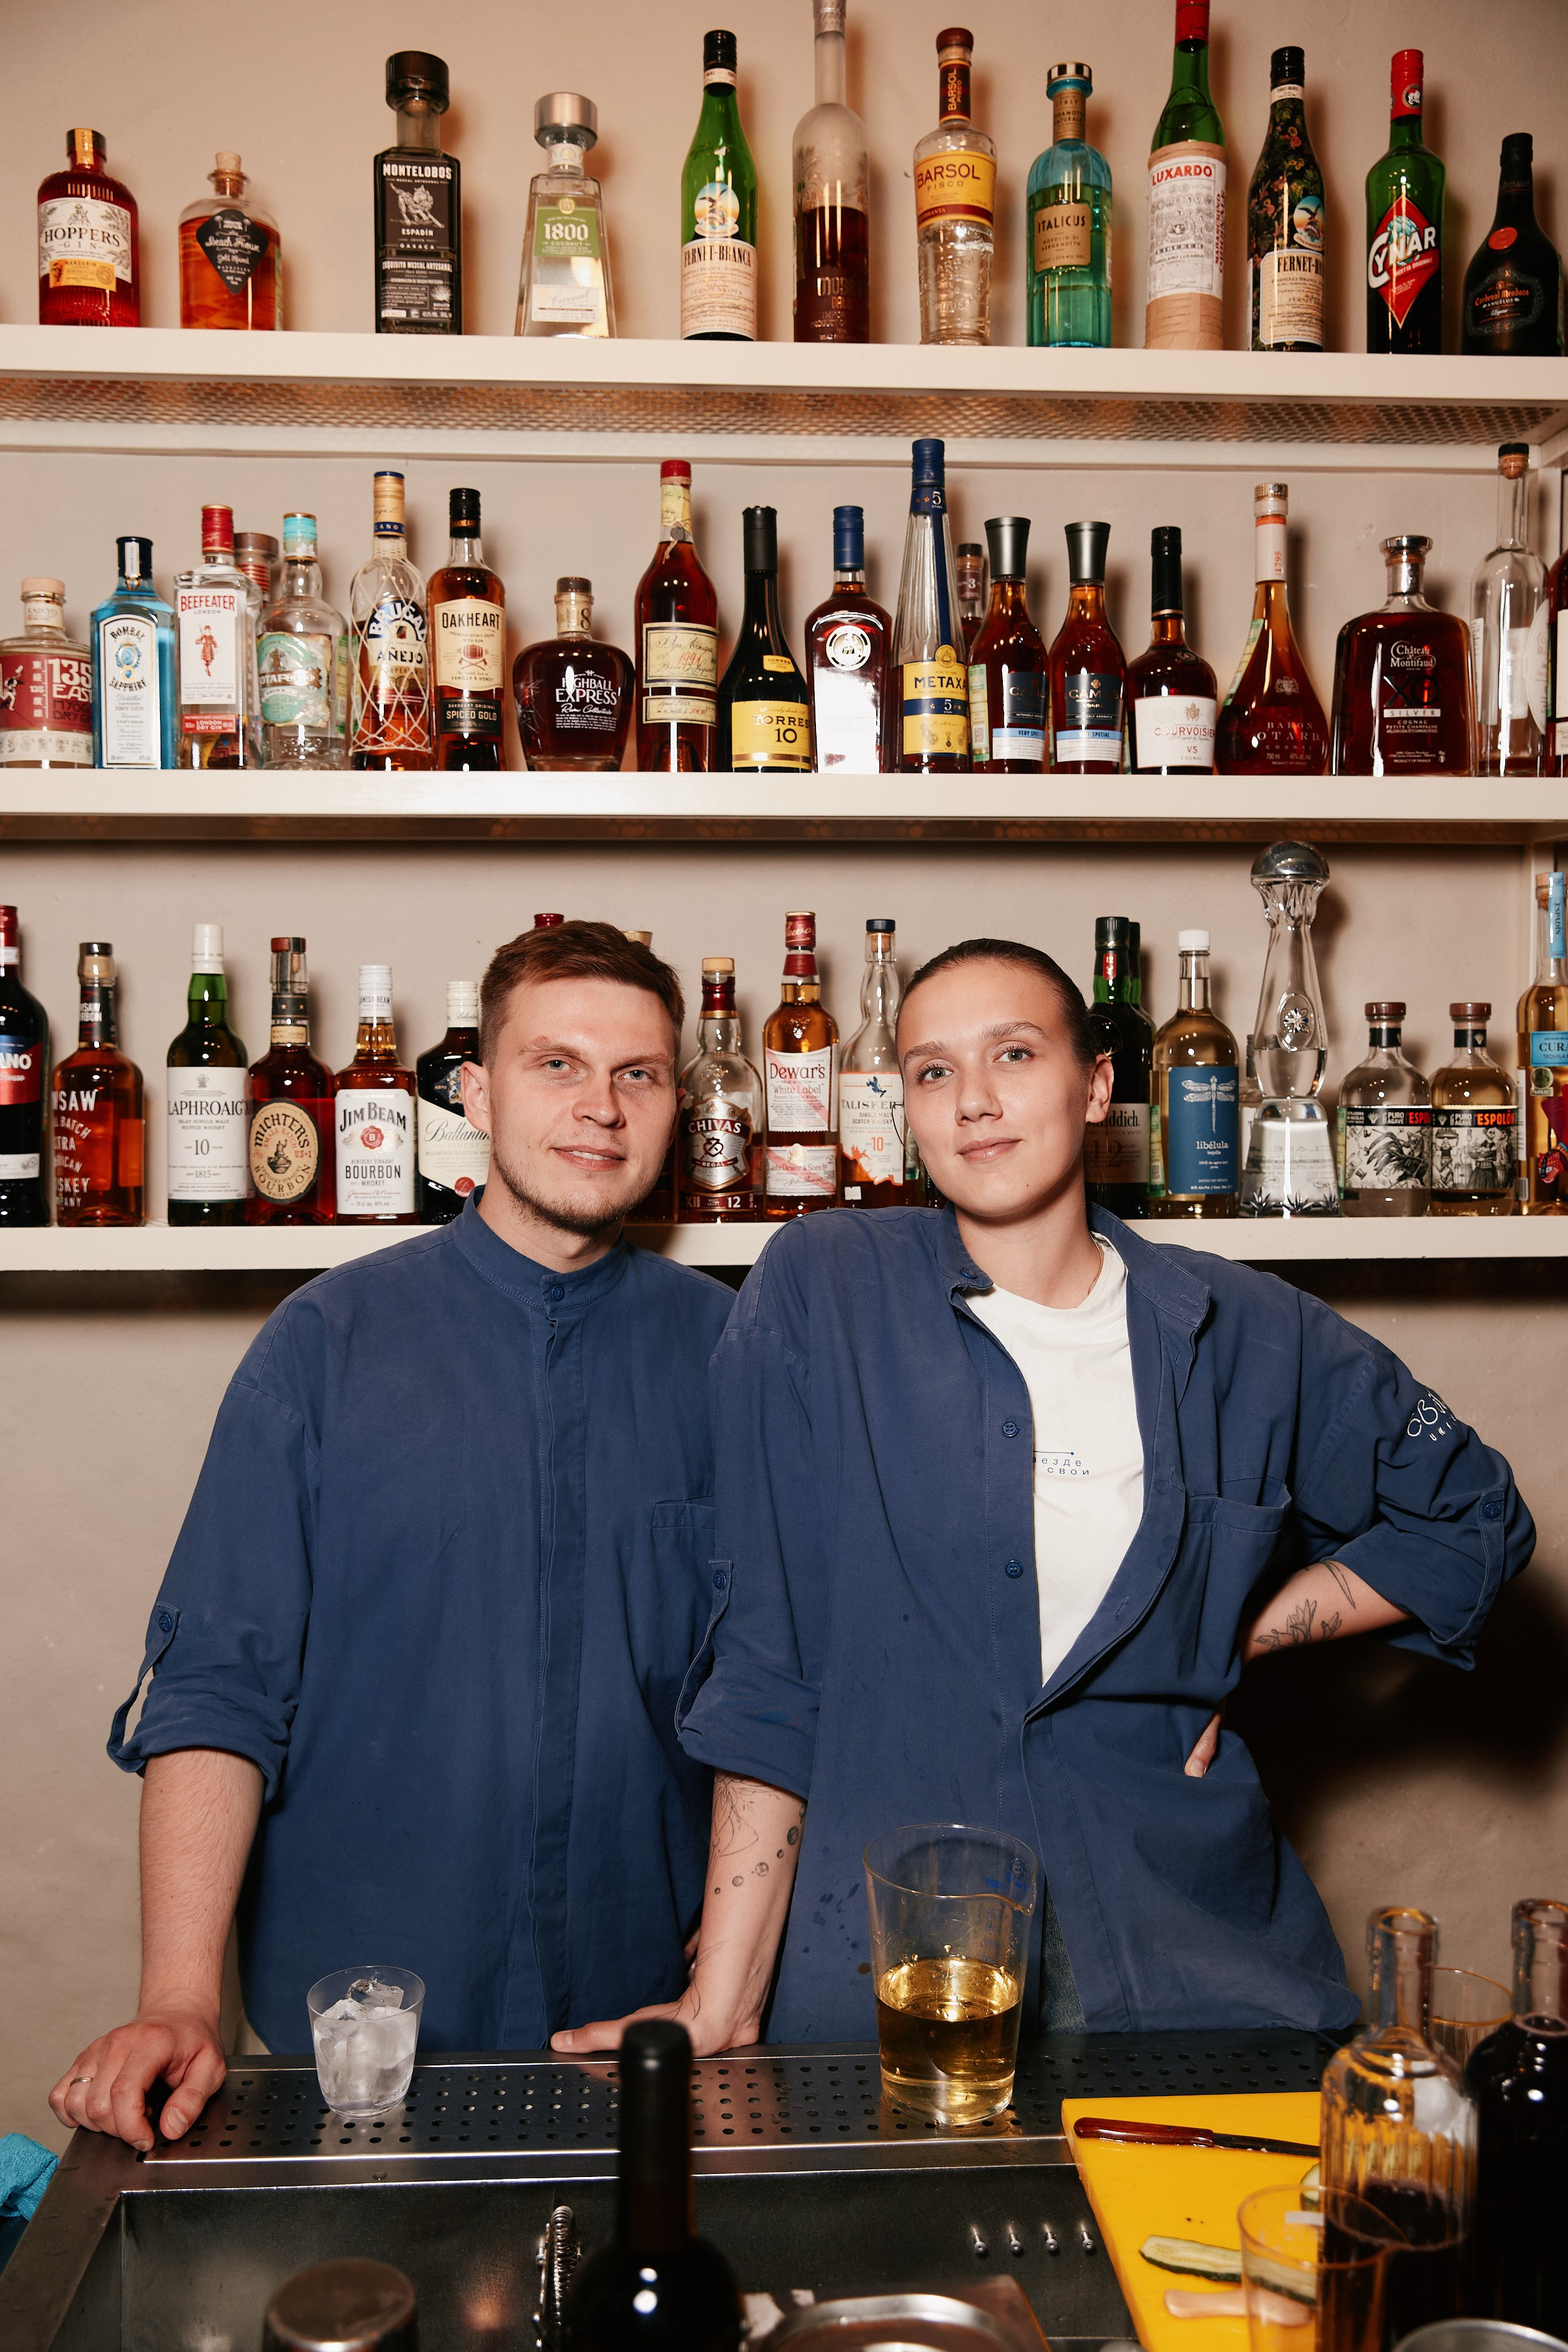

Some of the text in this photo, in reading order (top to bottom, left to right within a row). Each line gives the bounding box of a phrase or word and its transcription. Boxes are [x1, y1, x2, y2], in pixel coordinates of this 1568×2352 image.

[948, 69, 957, 111] BARSOL
[383, 163, 452, 180] MONTELOBOS
[918, 163, 980, 189] BARSOL
[1152, 165, 1212, 186] LUXARDO
[928, 181, 964, 192] PISCO
[401, 228, 433, 236] ESPADÍN
[544, 222, 589, 241] 1800
[1038, 215, 1085, 234] ITALICUS
[45, 227, 121, 248] HOPPERS
[63, 241, 97, 250] GIN
[406, 261, 425, 270] MEZCAL
[1368, 226, 1436, 289] CYNAR
[1475, 288, 1529, 306] Cardenal Mendoza
[932, 490, 941, 505] 5
[968, 578, 977, 589] 3
[181, 595, 236, 612] BEEFEATER
[369, 603, 426, 642] BRUGAL
[442, 613, 500, 630] OAKHEART
[110, 626, 145, 643] BOMBAY
[378, 647, 423, 664] AÑEJO
[1396, 644, 1430, 655] Château
[1390, 657, 1433, 667] Montifaud
[48, 659, 92, 689] 135
[109, 675, 149, 692] SAPPHIRE
[562, 677, 613, 691] HGHBALL
[1383, 675, 1440, 707] XO
[555, 688, 617, 706] EXPRESS
[944, 699, 952, 711] 5
[53, 699, 92, 713] HYOG
[54, 711, 78, 721] DRY
[446, 711, 497, 721] SPICED GOLD
[752, 715, 810, 729] TORRES
[775, 728, 798, 744] 10
[1154, 727, 1215, 738] COURVOISIER
[770, 1062, 825, 1079] Dewar's
[167, 1100, 243, 1116] LAPHROAIG
[841, 1099, 897, 1110] TALISKER
[340, 1102, 407, 1133] JIM BEAM
[1476, 1110, 1515, 1126] ESPOLÓN
[60, 1115, 92, 1140] BATCH
[254, 1113, 310, 1150] MICHTER'S
[688, 1119, 742, 1134] CHIVAS
[264, 1128, 280, 1148] SMALL
[871, 1136, 884, 1152] 10
[1195, 1141, 1229, 1150] libélula
[194, 1139, 209, 1155] 10
[195, 1170, 211, 1179] 1815
[254, 1164, 311, 1193] BOURBON
[346, 1165, 401, 1179] BOURBON
[727, 1196, 741, 1208] 12
